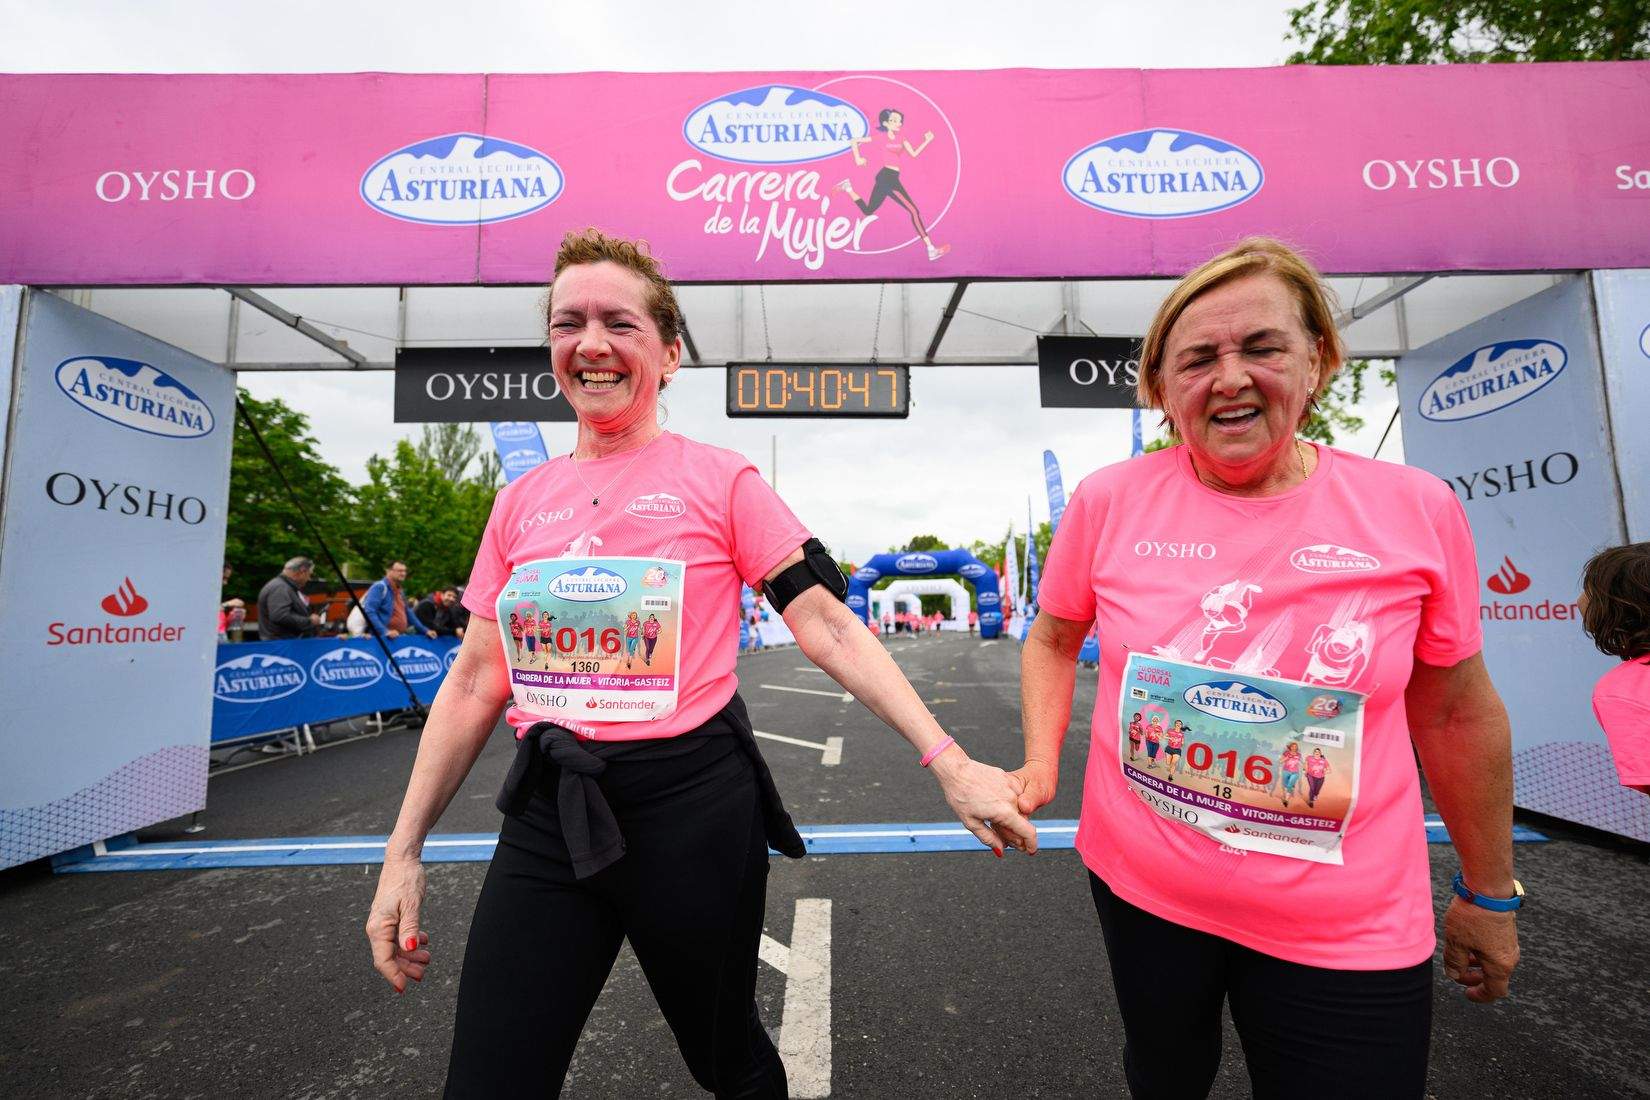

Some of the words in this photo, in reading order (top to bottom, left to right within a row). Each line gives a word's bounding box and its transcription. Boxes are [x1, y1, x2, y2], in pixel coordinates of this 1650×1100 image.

[698, 114, 853, 144] ASTURIANA
[726, 111, 783, 120] CENTRAL
[408, 165, 472, 176] CENTRAL
[478, 163, 542, 174] LECHERA
[1107, 159, 1169, 169] CENTRAL
[1175, 157, 1240, 167] LECHERA
[1362, 157, 1520, 191] OYSHO
[95, 169, 256, 203] OYSHO
[377, 169, 547, 202] ASTURIANA
[666, 159, 820, 202] Carrera
[1080, 160, 1249, 194] ASTURIANA
[704, 204, 729, 234] de
[738, 203, 760, 234] la
[756, 195, 879, 270] Mujer
[1069, 358, 1140, 386] OYS
[69, 368, 205, 431] ASTURIANA
[426, 373, 561, 401] OYSHO
[737, 369, 897, 409] 00:40:47
[1428, 357, 1555, 416] ASTURIANA
[1441, 452, 1579, 501] YSHO
[46, 472, 206, 525] OYSHO
[1134, 540, 1217, 560] OYSHO
[553, 578, 621, 593] ASTURIANA
[1480, 600, 1578, 621] ntander
[47, 622, 186, 646] Santander
[555, 627, 622, 654] 016
[319, 664, 379, 682] ASTURIANA
[393, 662, 440, 677] STURIANA
[515, 672, 543, 683] CARRERA
[543, 675, 553, 684] DE
[554, 676, 564, 685] LA
[565, 676, 592, 686] MUJER
[598, 677, 670, 687] VITORIA-GASTEIZ
[571, 661, 600, 673] 1360
[1136, 671, 1171, 688] SUMA
[216, 672, 301, 695] ASTURIANA
[526, 691, 567, 708] OYSHO
[598, 698, 656, 710] Santander
[1190, 690, 1279, 719] ASTURIANA
[1186, 742, 1274, 785] 016
[1127, 767, 1165, 791] CARRERA
[1166, 785, 1180, 797] DE
[1181, 790, 1194, 802] LA
[1196, 795, 1232, 813] MUJER
[1241, 807, 1338, 829] VITORIA-GASTEIZ
[1213, 784, 1233, 800] 18
[1141, 790, 1199, 825] OYSHO
[1242, 827, 1315, 846] Santander
